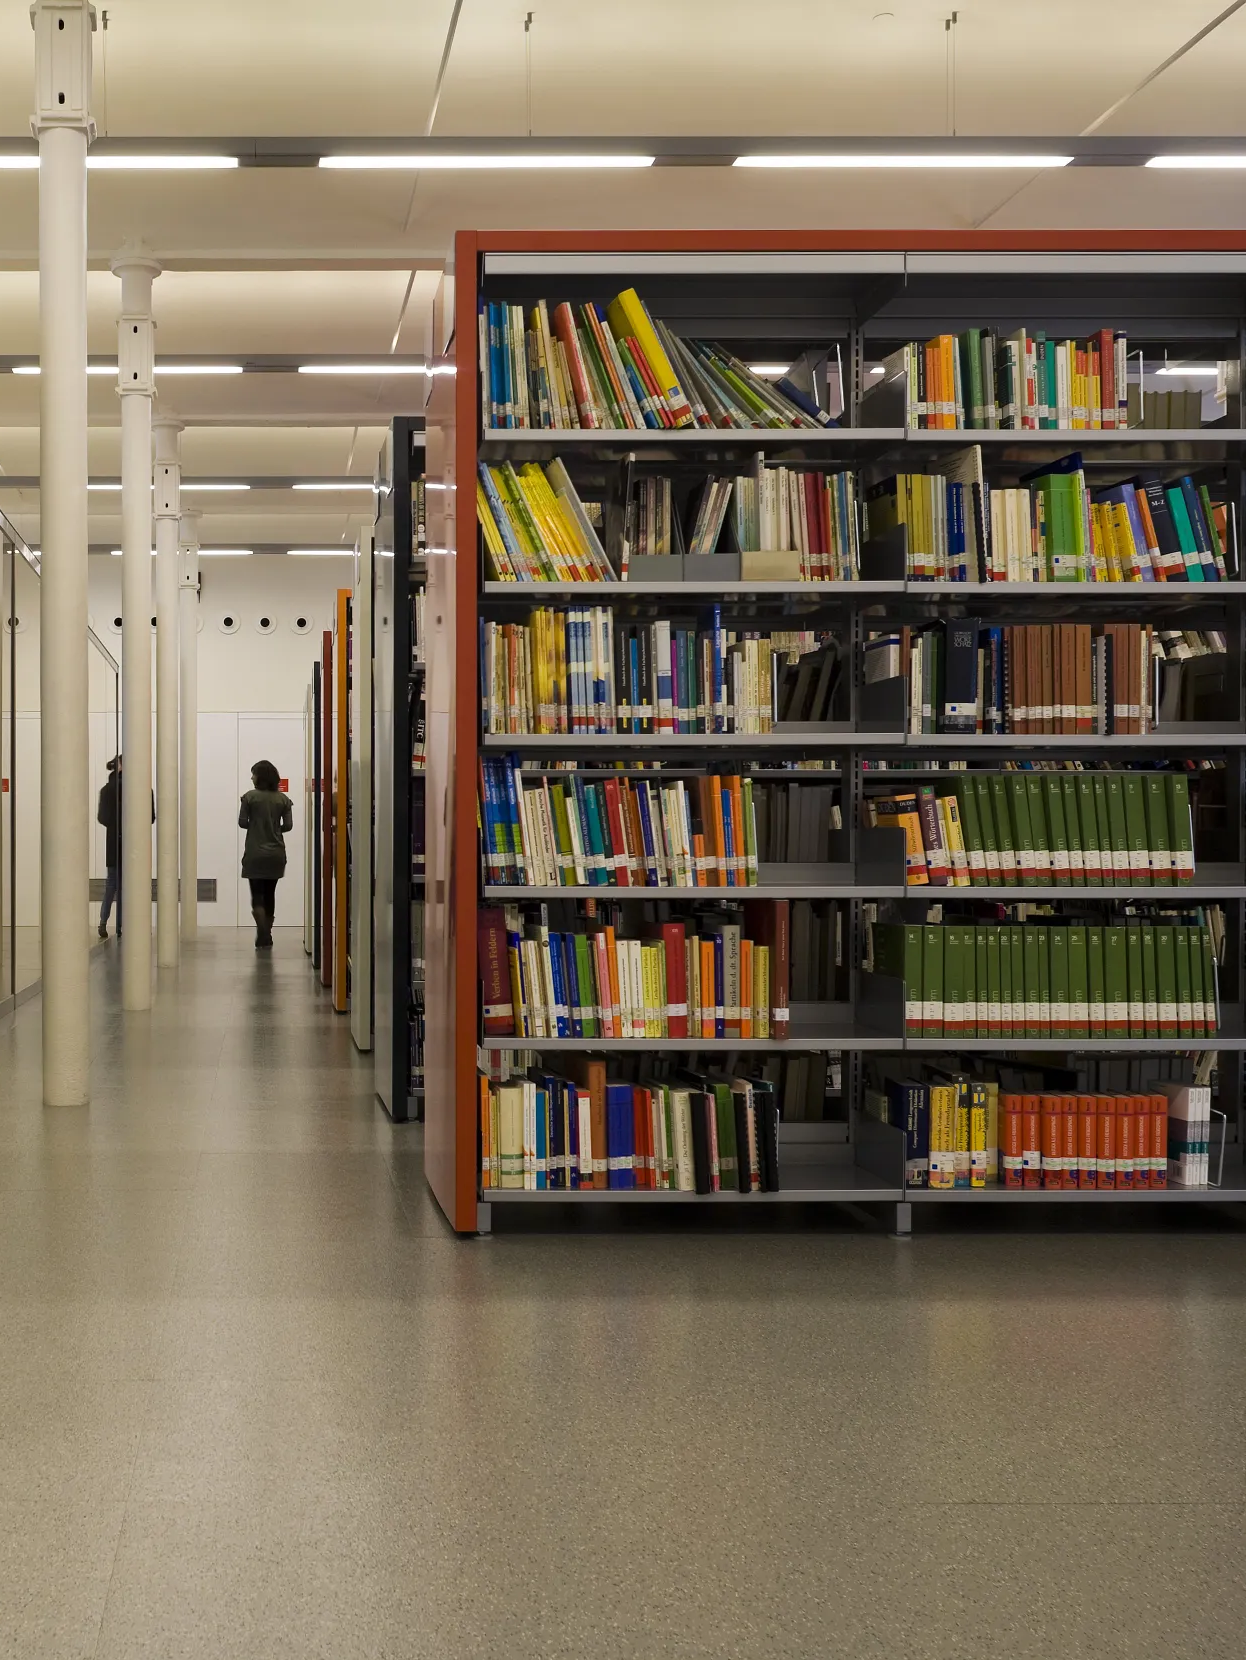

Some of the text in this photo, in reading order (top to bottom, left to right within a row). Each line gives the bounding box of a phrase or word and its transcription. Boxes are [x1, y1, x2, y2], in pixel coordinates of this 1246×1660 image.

[1151, 499, 1166, 507] M-Z
[925, 803, 938, 841] Wörterbuch
[729, 932, 737, 960] Sprache
[488, 927, 501, 1000] Verben in Feldern
